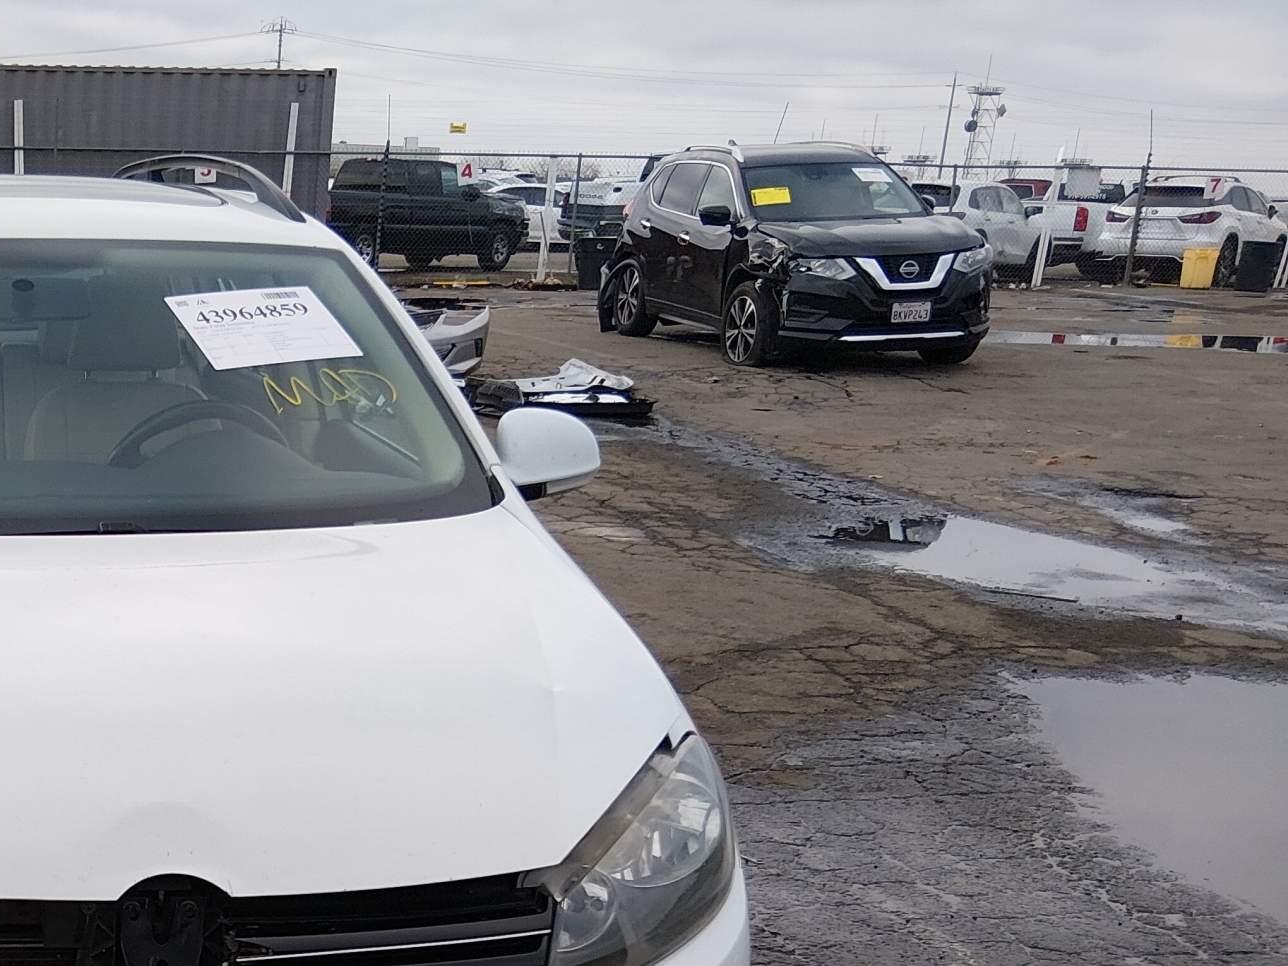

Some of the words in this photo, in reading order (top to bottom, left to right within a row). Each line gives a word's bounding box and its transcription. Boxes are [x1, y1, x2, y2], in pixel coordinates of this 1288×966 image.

[461, 163, 473, 179] 4
[1210, 178, 1222, 193] 7
[196, 302, 309, 325] 43964859
